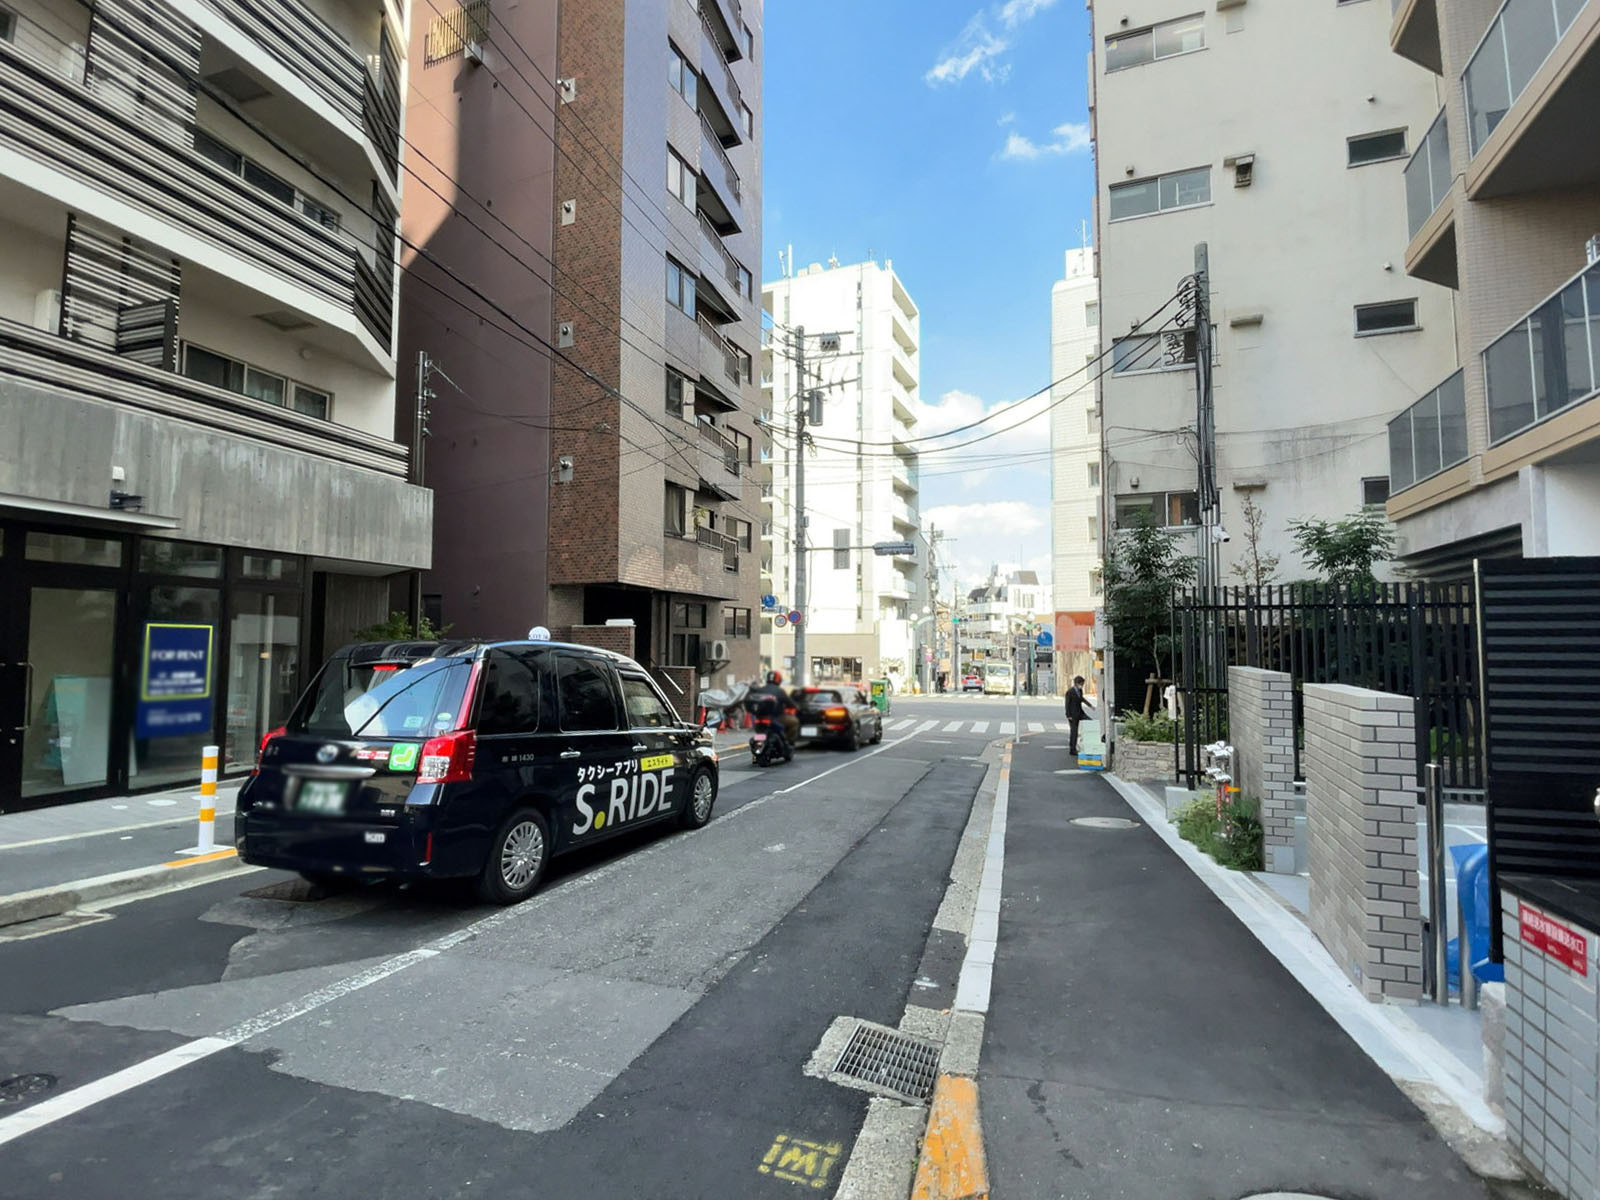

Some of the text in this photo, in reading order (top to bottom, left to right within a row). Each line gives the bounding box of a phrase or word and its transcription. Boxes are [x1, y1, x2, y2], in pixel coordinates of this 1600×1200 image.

[151, 650, 204, 660] FOR RENT
[577, 759, 638, 783] タクシーアプリ
[572, 768, 675, 835] S.RIDE
